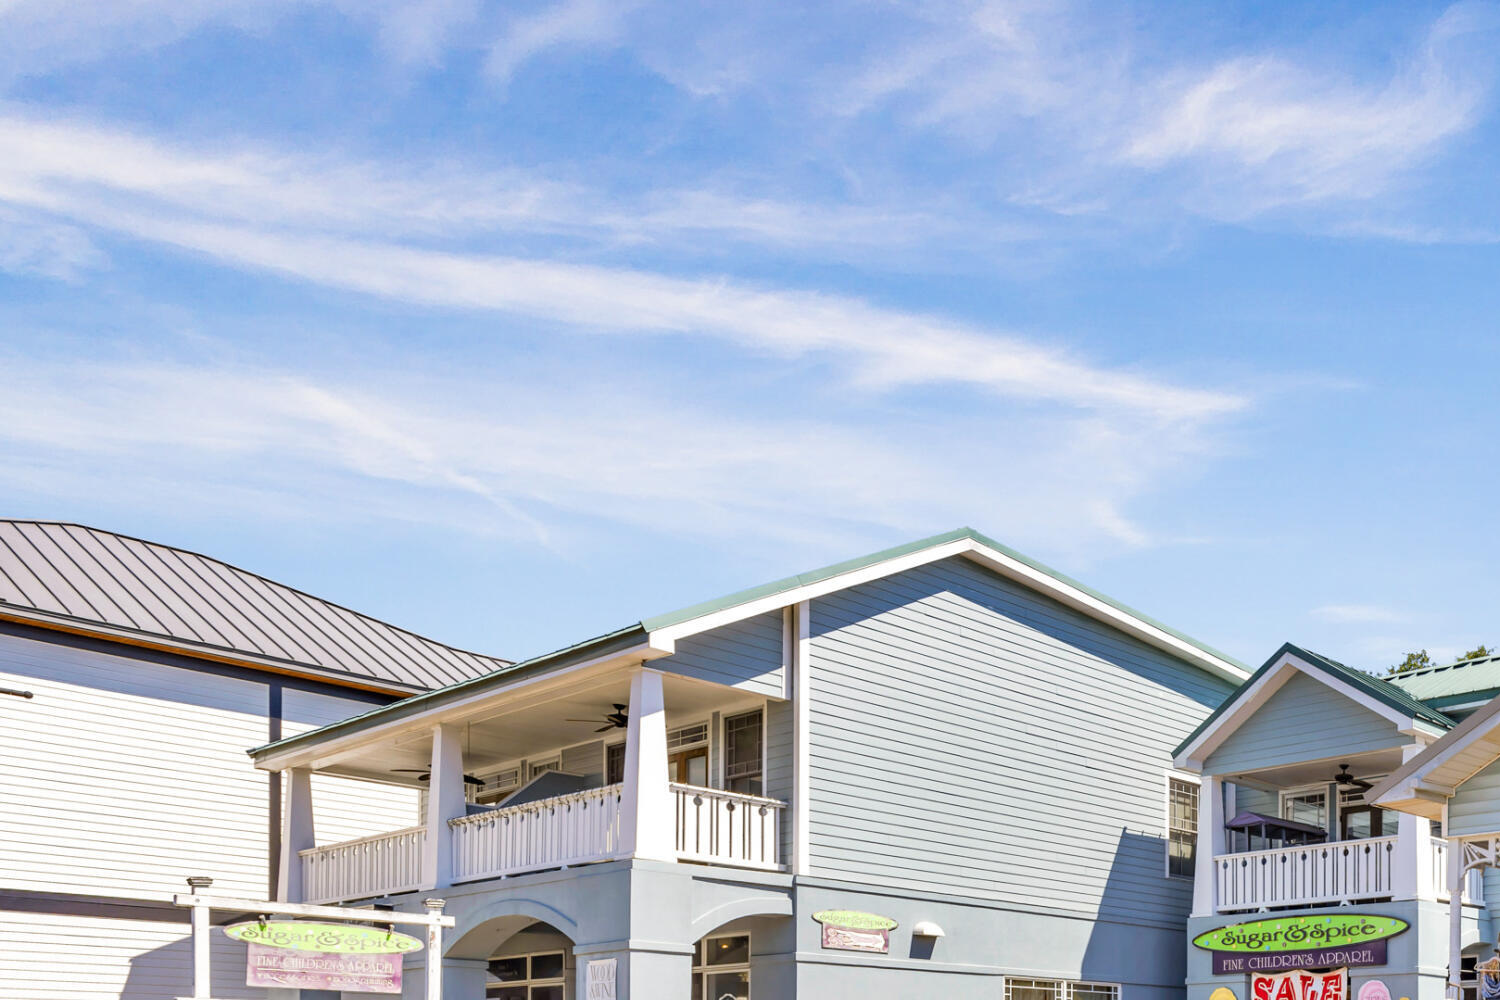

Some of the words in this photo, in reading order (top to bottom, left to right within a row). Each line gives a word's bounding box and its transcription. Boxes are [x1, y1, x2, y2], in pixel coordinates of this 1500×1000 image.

[1223, 958, 1244, 970] FINE
[1249, 953, 1314, 969] CHILDREN'S
[1318, 950, 1374, 965] APPAREL
